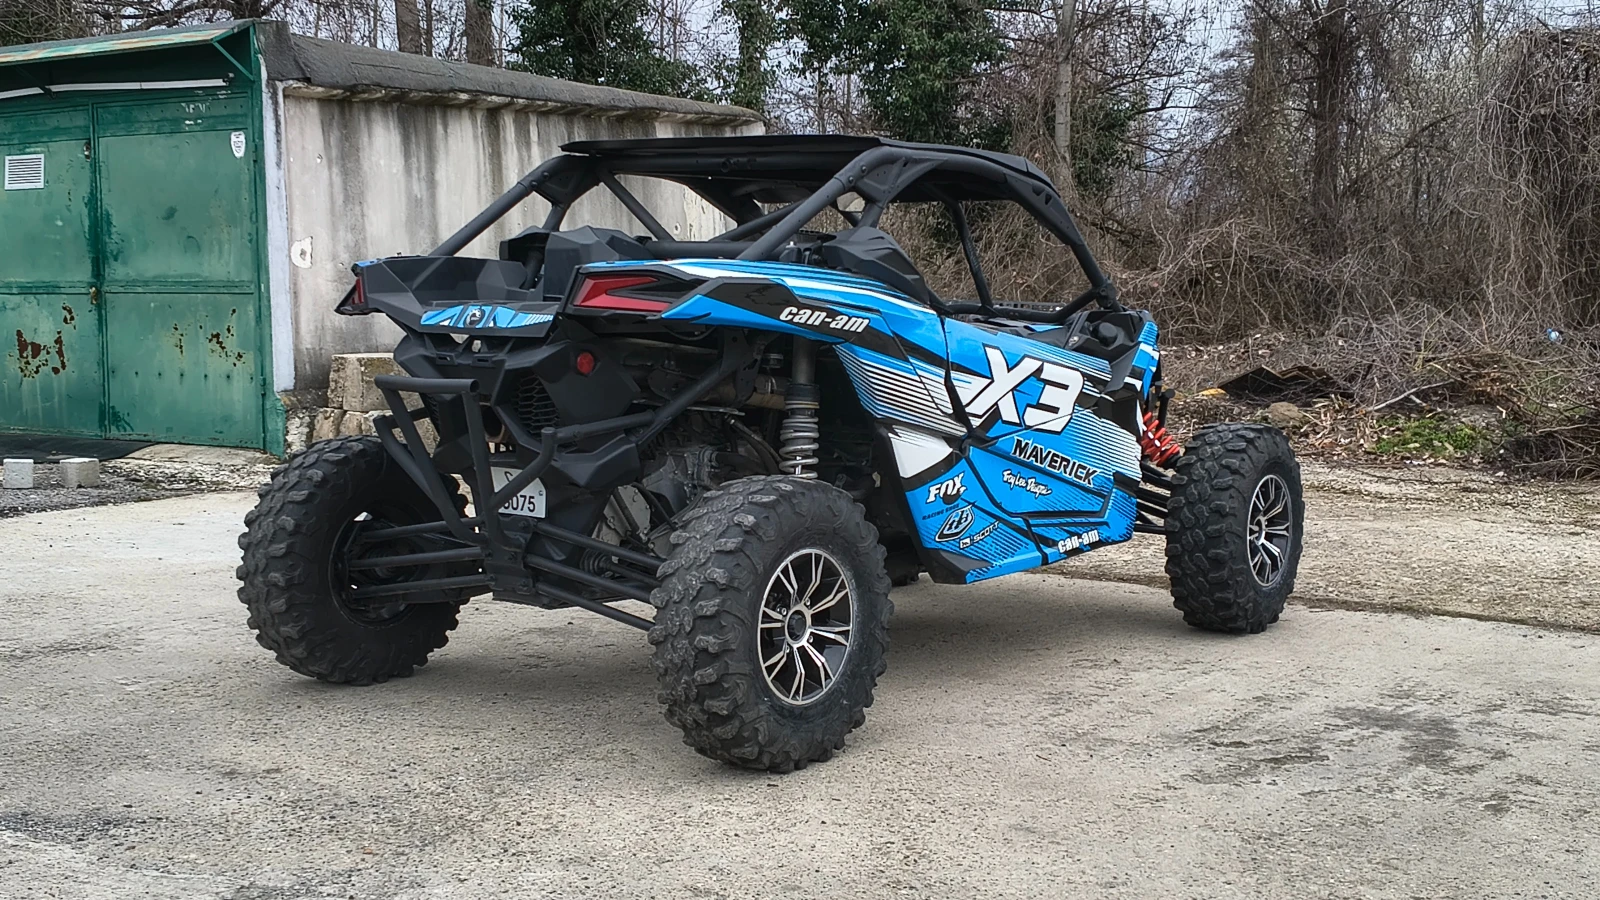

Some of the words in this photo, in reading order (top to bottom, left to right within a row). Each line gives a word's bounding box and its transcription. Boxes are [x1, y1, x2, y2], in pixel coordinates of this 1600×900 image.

[780, 306, 870, 333] can-am
[965, 346, 1084, 432] X3
[1012, 437, 1098, 486] MAVERICK
[926, 472, 967, 503] FOX
[973, 521, 999, 543] SCOTT
[1058, 530, 1099, 553] can-am
